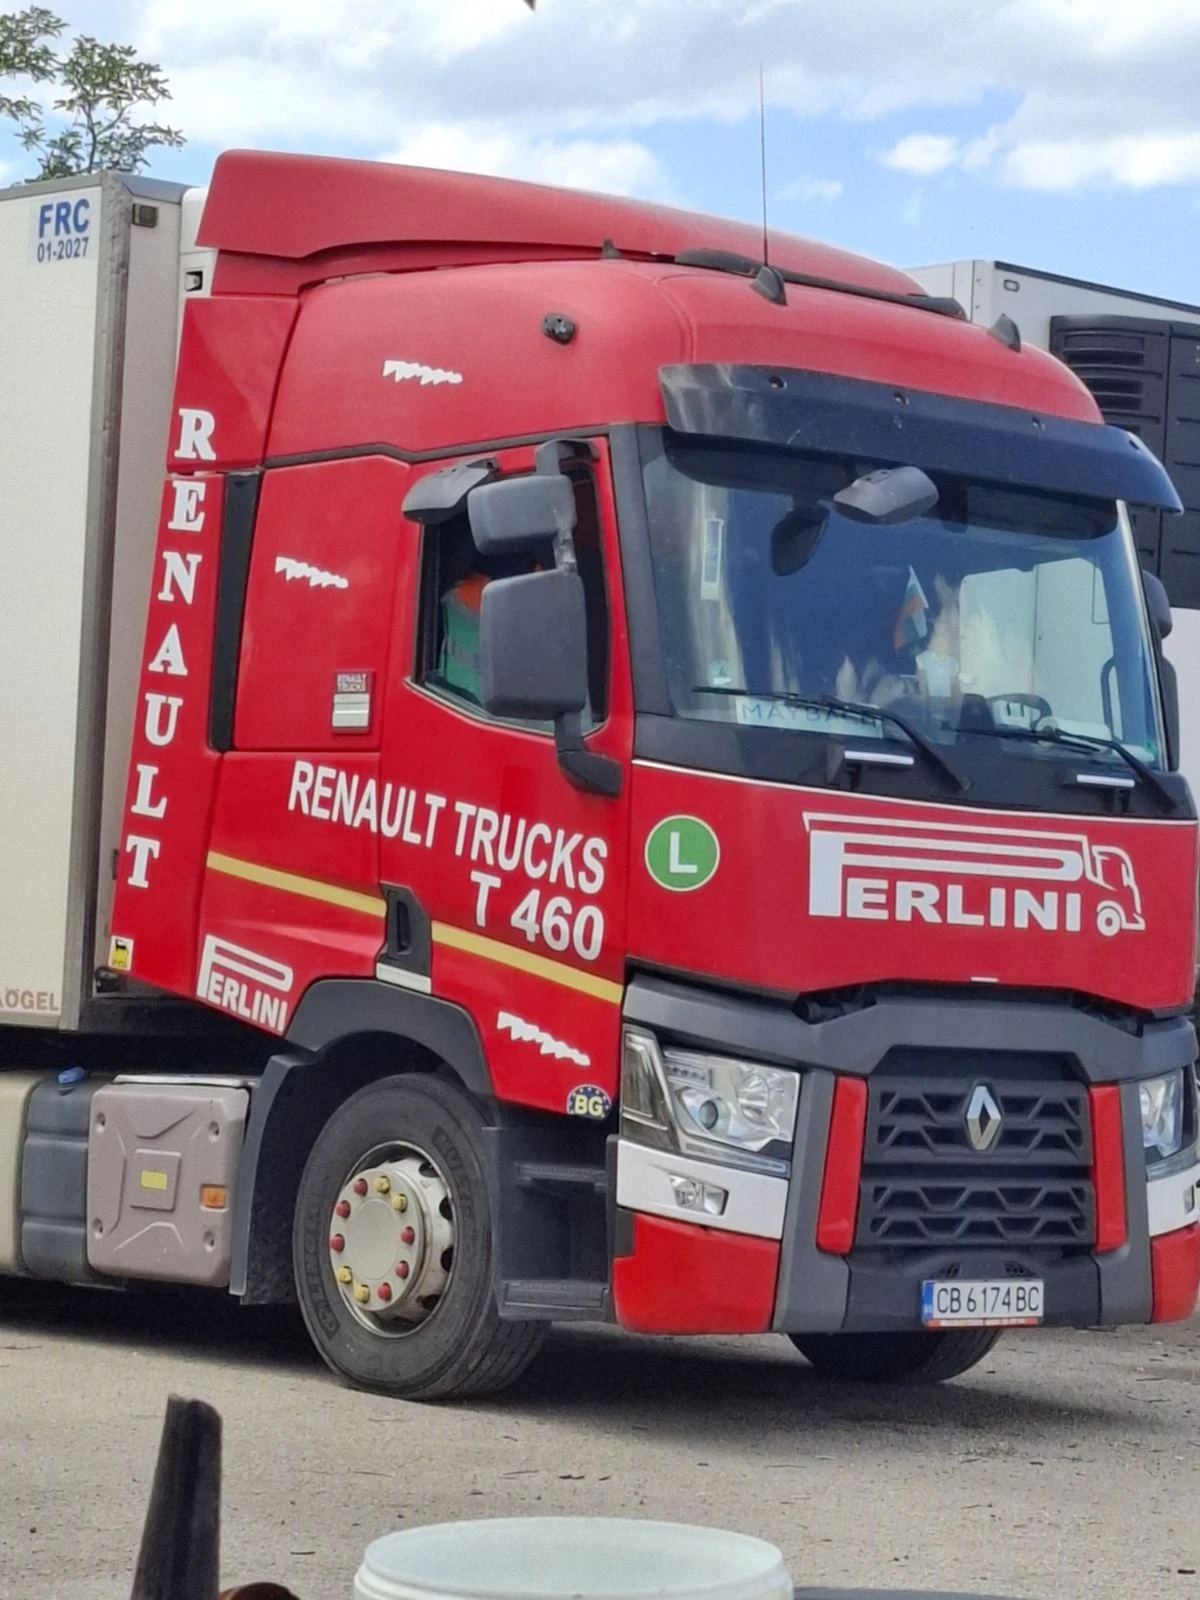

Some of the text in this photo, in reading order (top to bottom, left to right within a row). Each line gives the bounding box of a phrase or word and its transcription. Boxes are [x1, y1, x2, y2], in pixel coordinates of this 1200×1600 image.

[37, 237, 89, 263] 01-2027
[39, 198, 90, 239] FRC
[126, 408, 217, 889] RENAULT
[288, 760, 608, 895] RENAULT TRUCKS
[669, 831, 698, 874] L
[808, 829, 1083, 933] PERLINI
[470, 870, 605, 961] T 460
[0, 988, 59, 1012] ÖGEL
[196, 933, 294, 1034] PERLINI
[574, 1094, 604, 1116] BG
